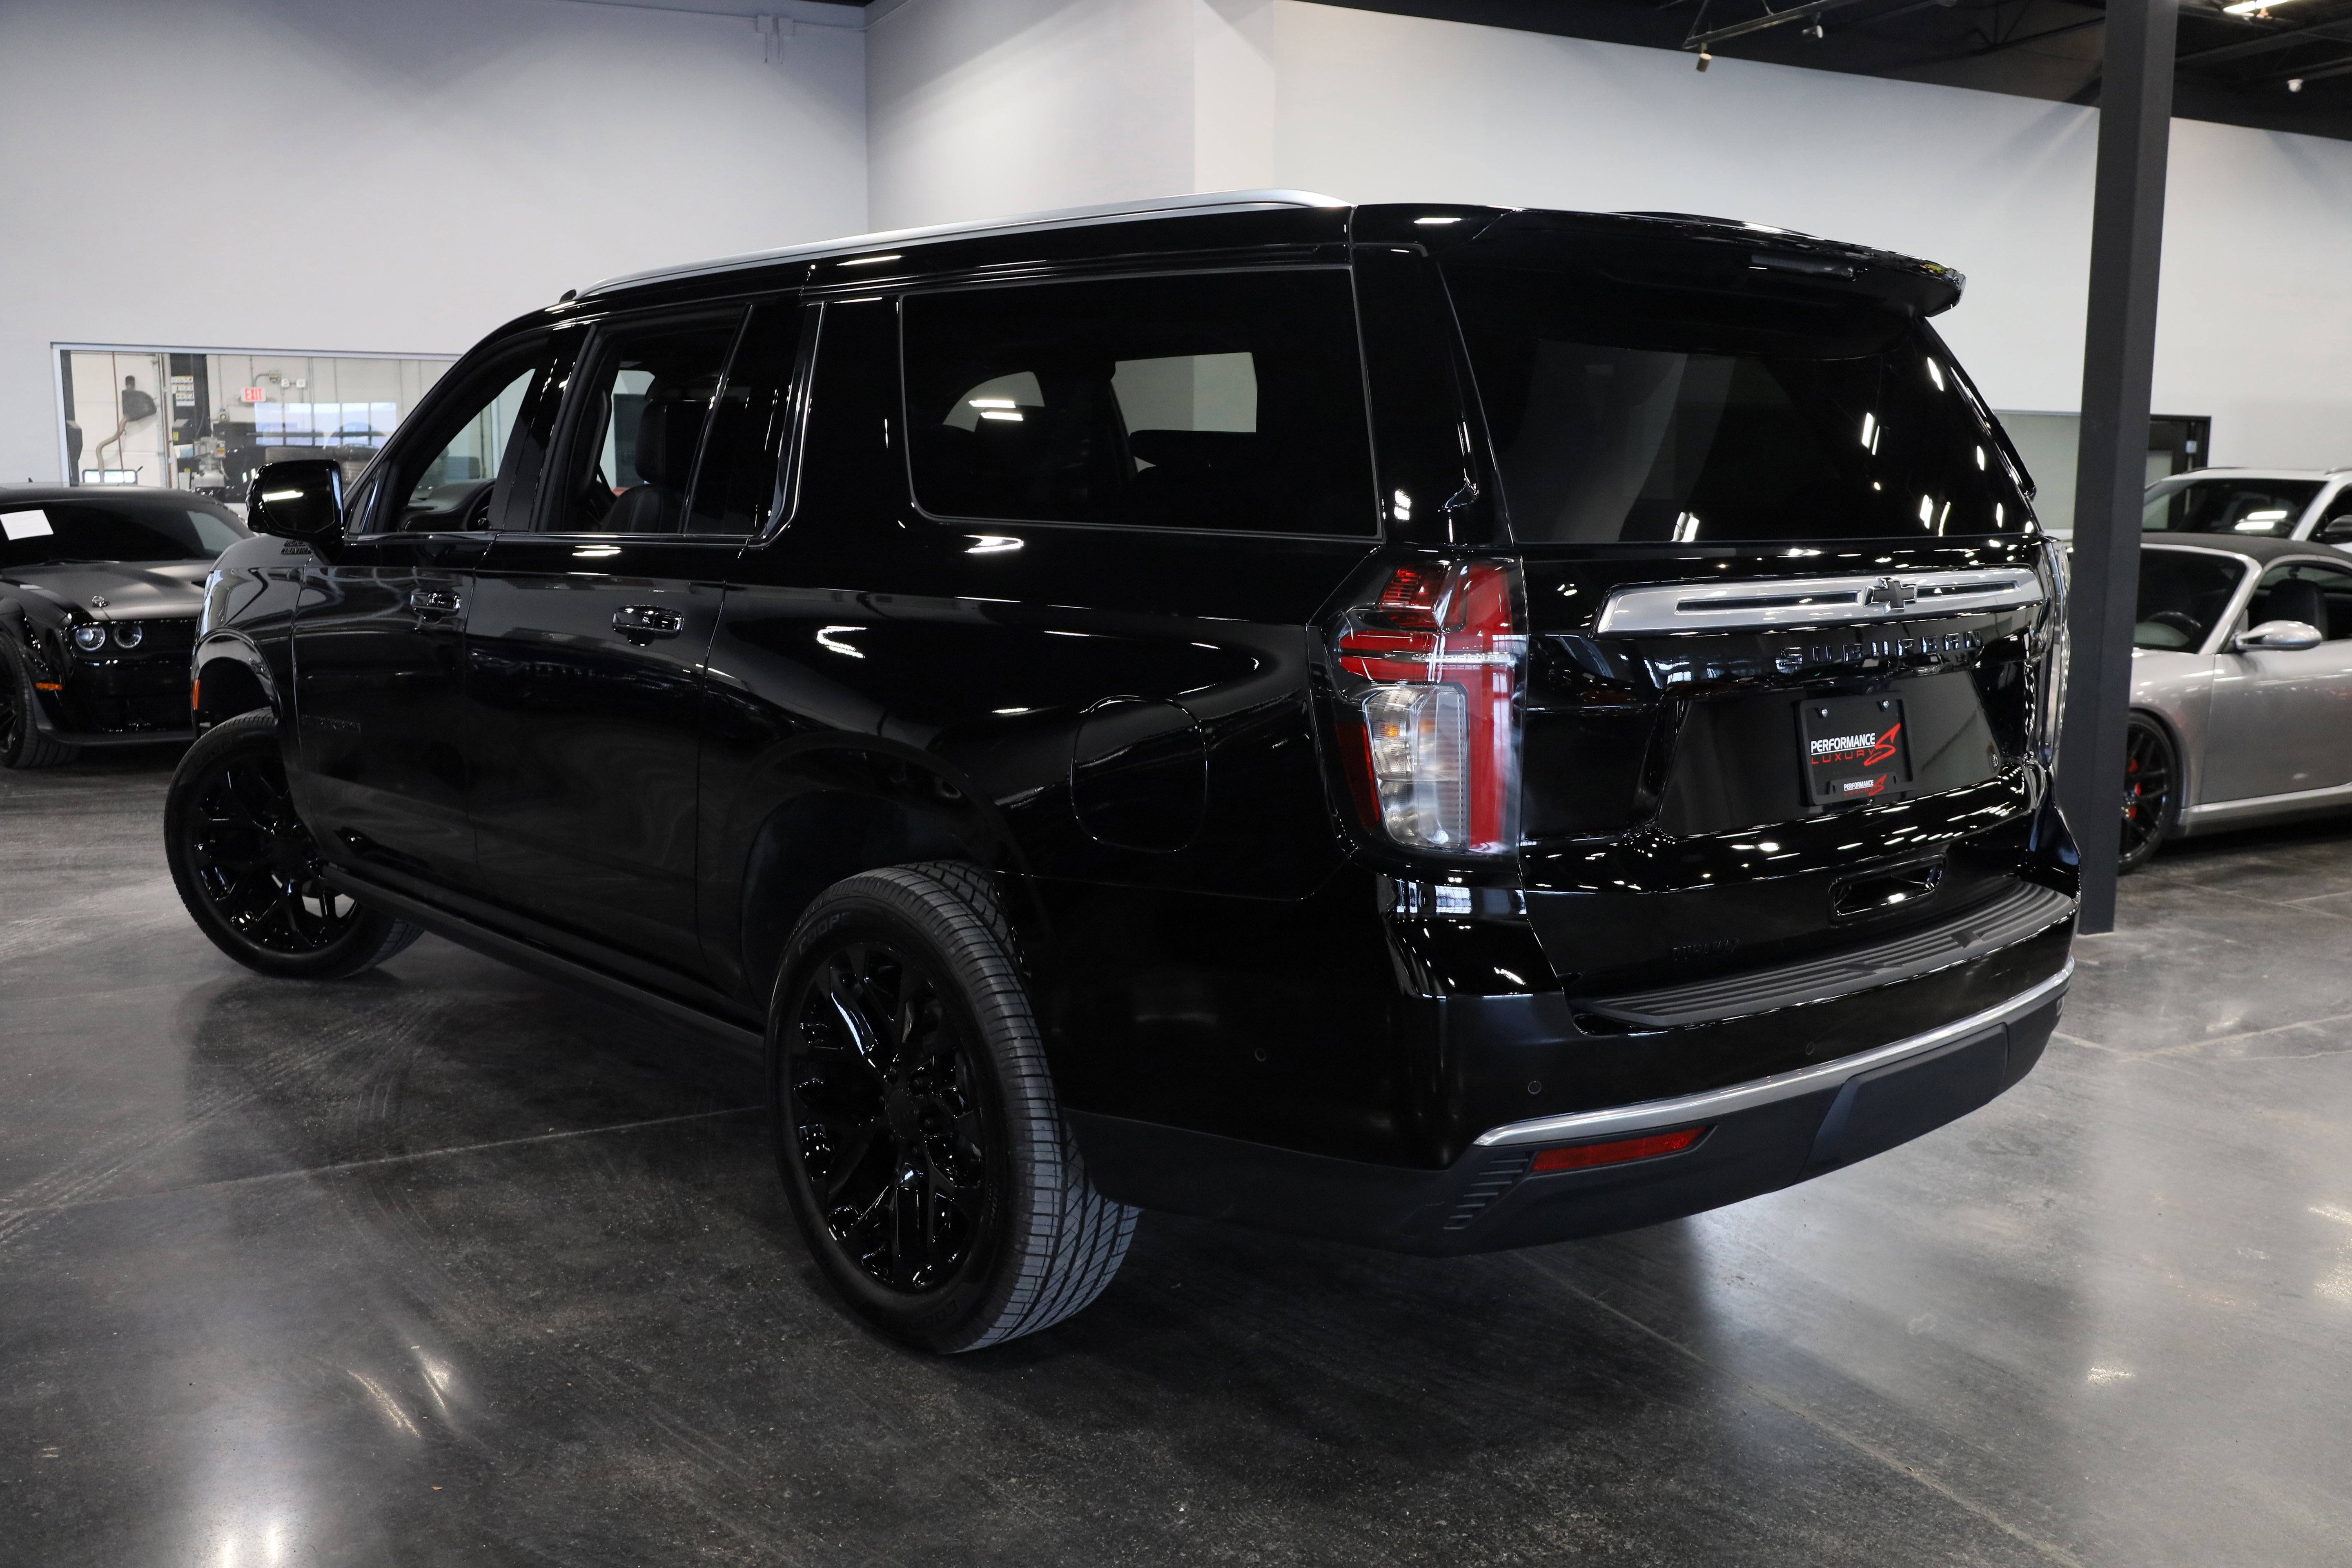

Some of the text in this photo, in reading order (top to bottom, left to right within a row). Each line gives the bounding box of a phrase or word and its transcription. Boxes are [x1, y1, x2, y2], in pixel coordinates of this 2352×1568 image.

[245, 388, 263, 401] EXIT
[1778, 630, 1984, 666] SUBURBAN
[1445, 655, 1500, 663] CHEVROLET
[1811, 732, 1875, 753] PERFORMANCE
[1811, 749, 1875, 764] LUXURY
[1844, 779, 1874, 790] PERFORMANCE
